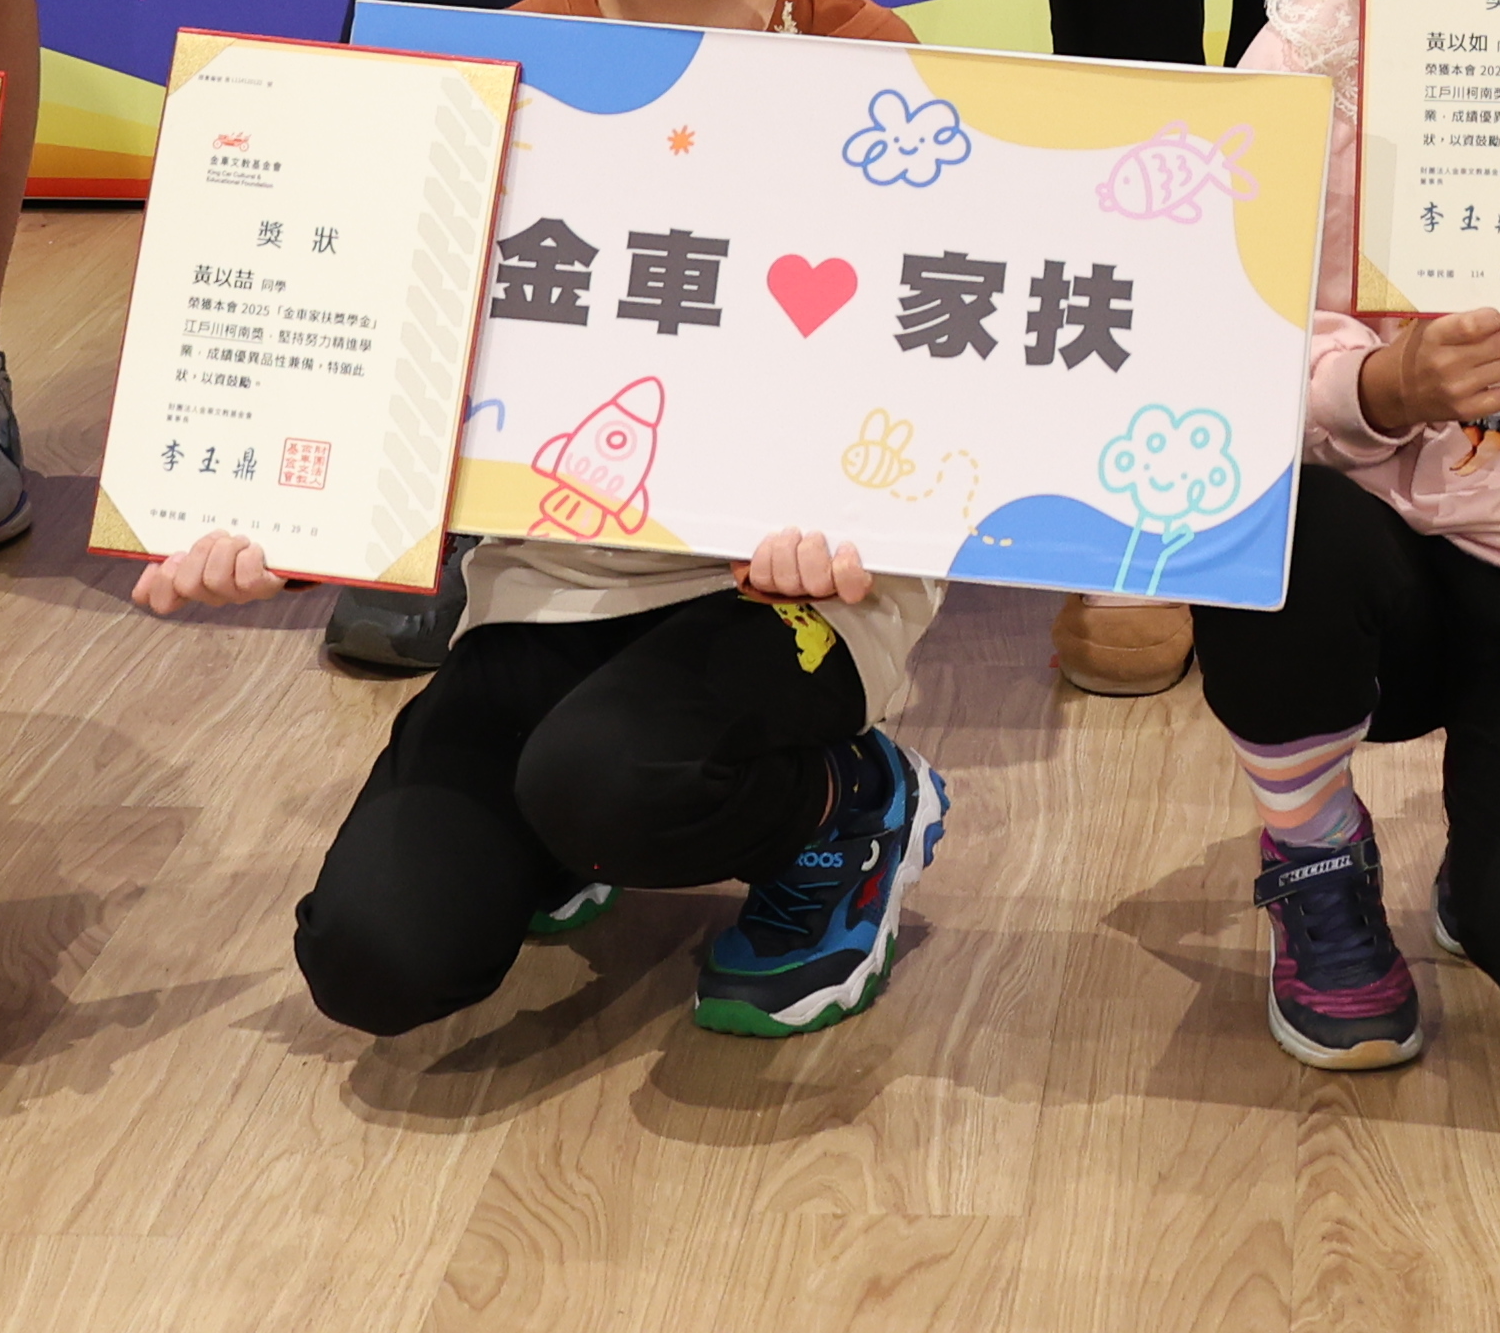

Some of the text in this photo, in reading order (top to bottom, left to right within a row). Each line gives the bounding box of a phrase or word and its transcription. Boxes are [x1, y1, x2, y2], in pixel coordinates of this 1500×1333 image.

[1426, 32, 1488, 53] 黃以如
[209, 155, 282, 172] 金車文教基金會
[191, 264, 287, 294] 黃以喆 同學
[490, 216, 1135, 374] 金車 家扶
